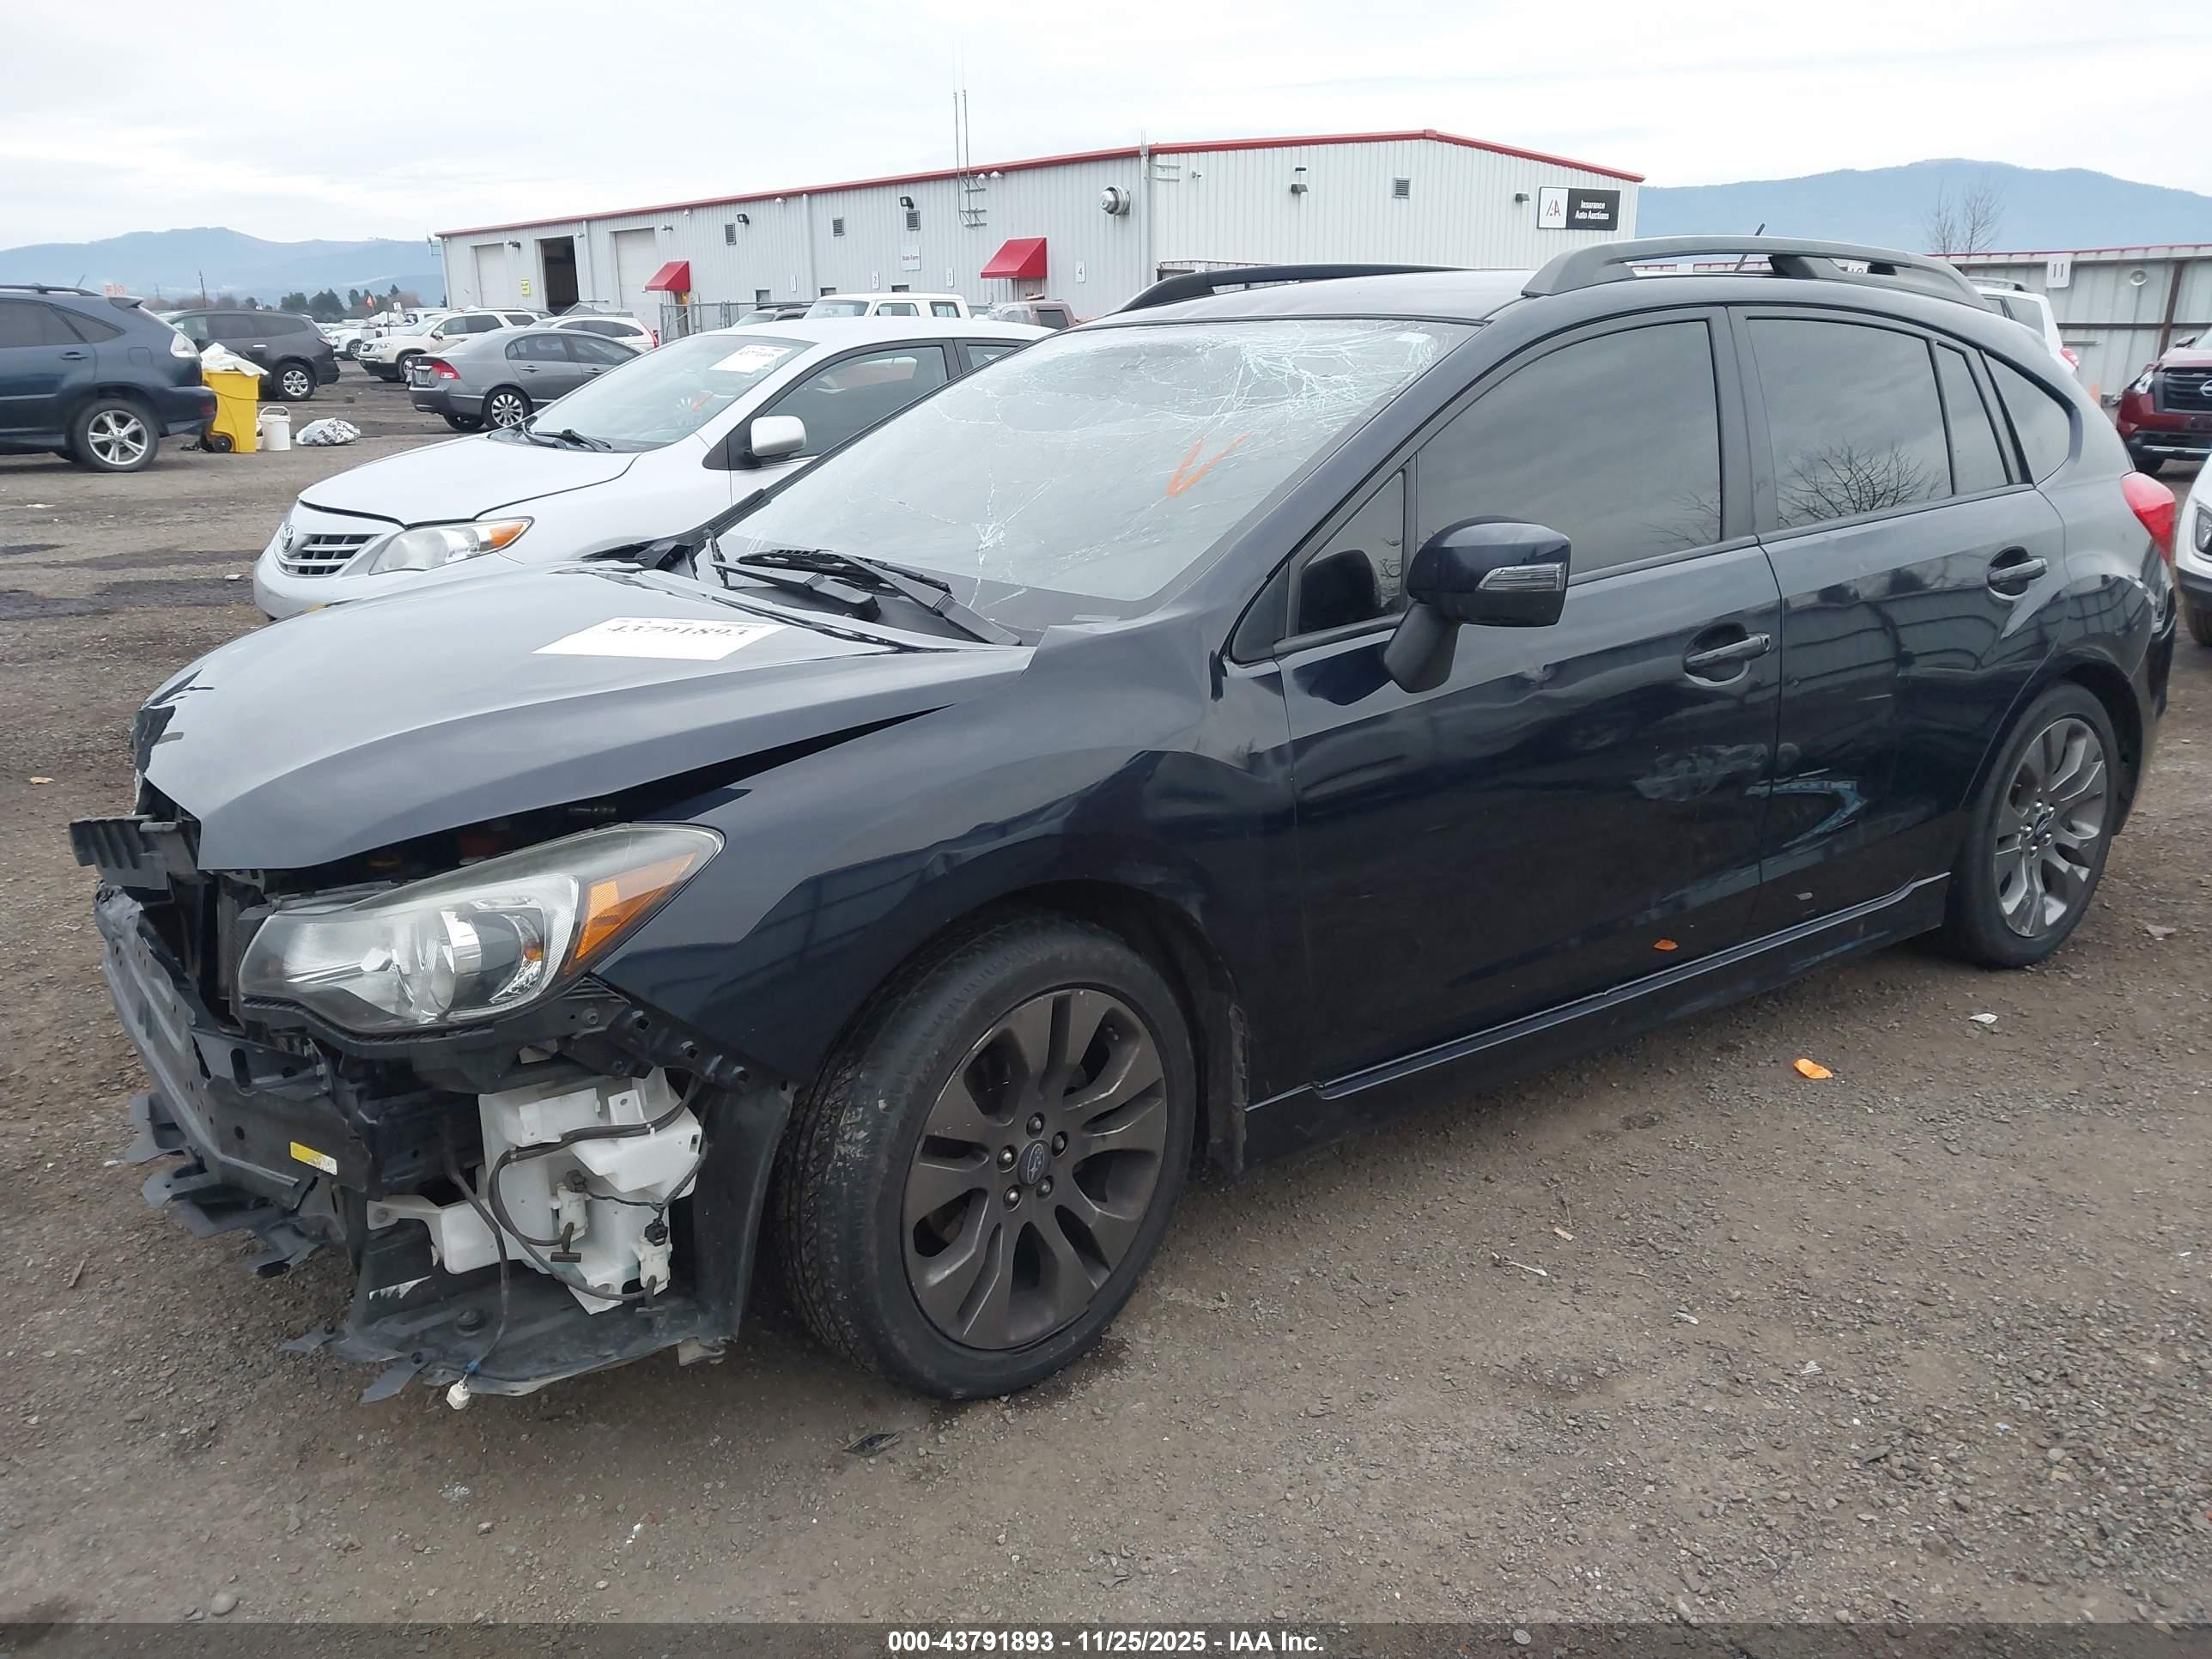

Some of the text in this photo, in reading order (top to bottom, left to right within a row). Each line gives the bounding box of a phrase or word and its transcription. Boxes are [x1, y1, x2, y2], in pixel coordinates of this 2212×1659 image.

[1580, 199, 1606, 210] Insurance
[1575, 210, 1610, 220] Auto Auctions
[1078, 267, 1083, 276] 4
[2053, 263, 2064, 277] 11
